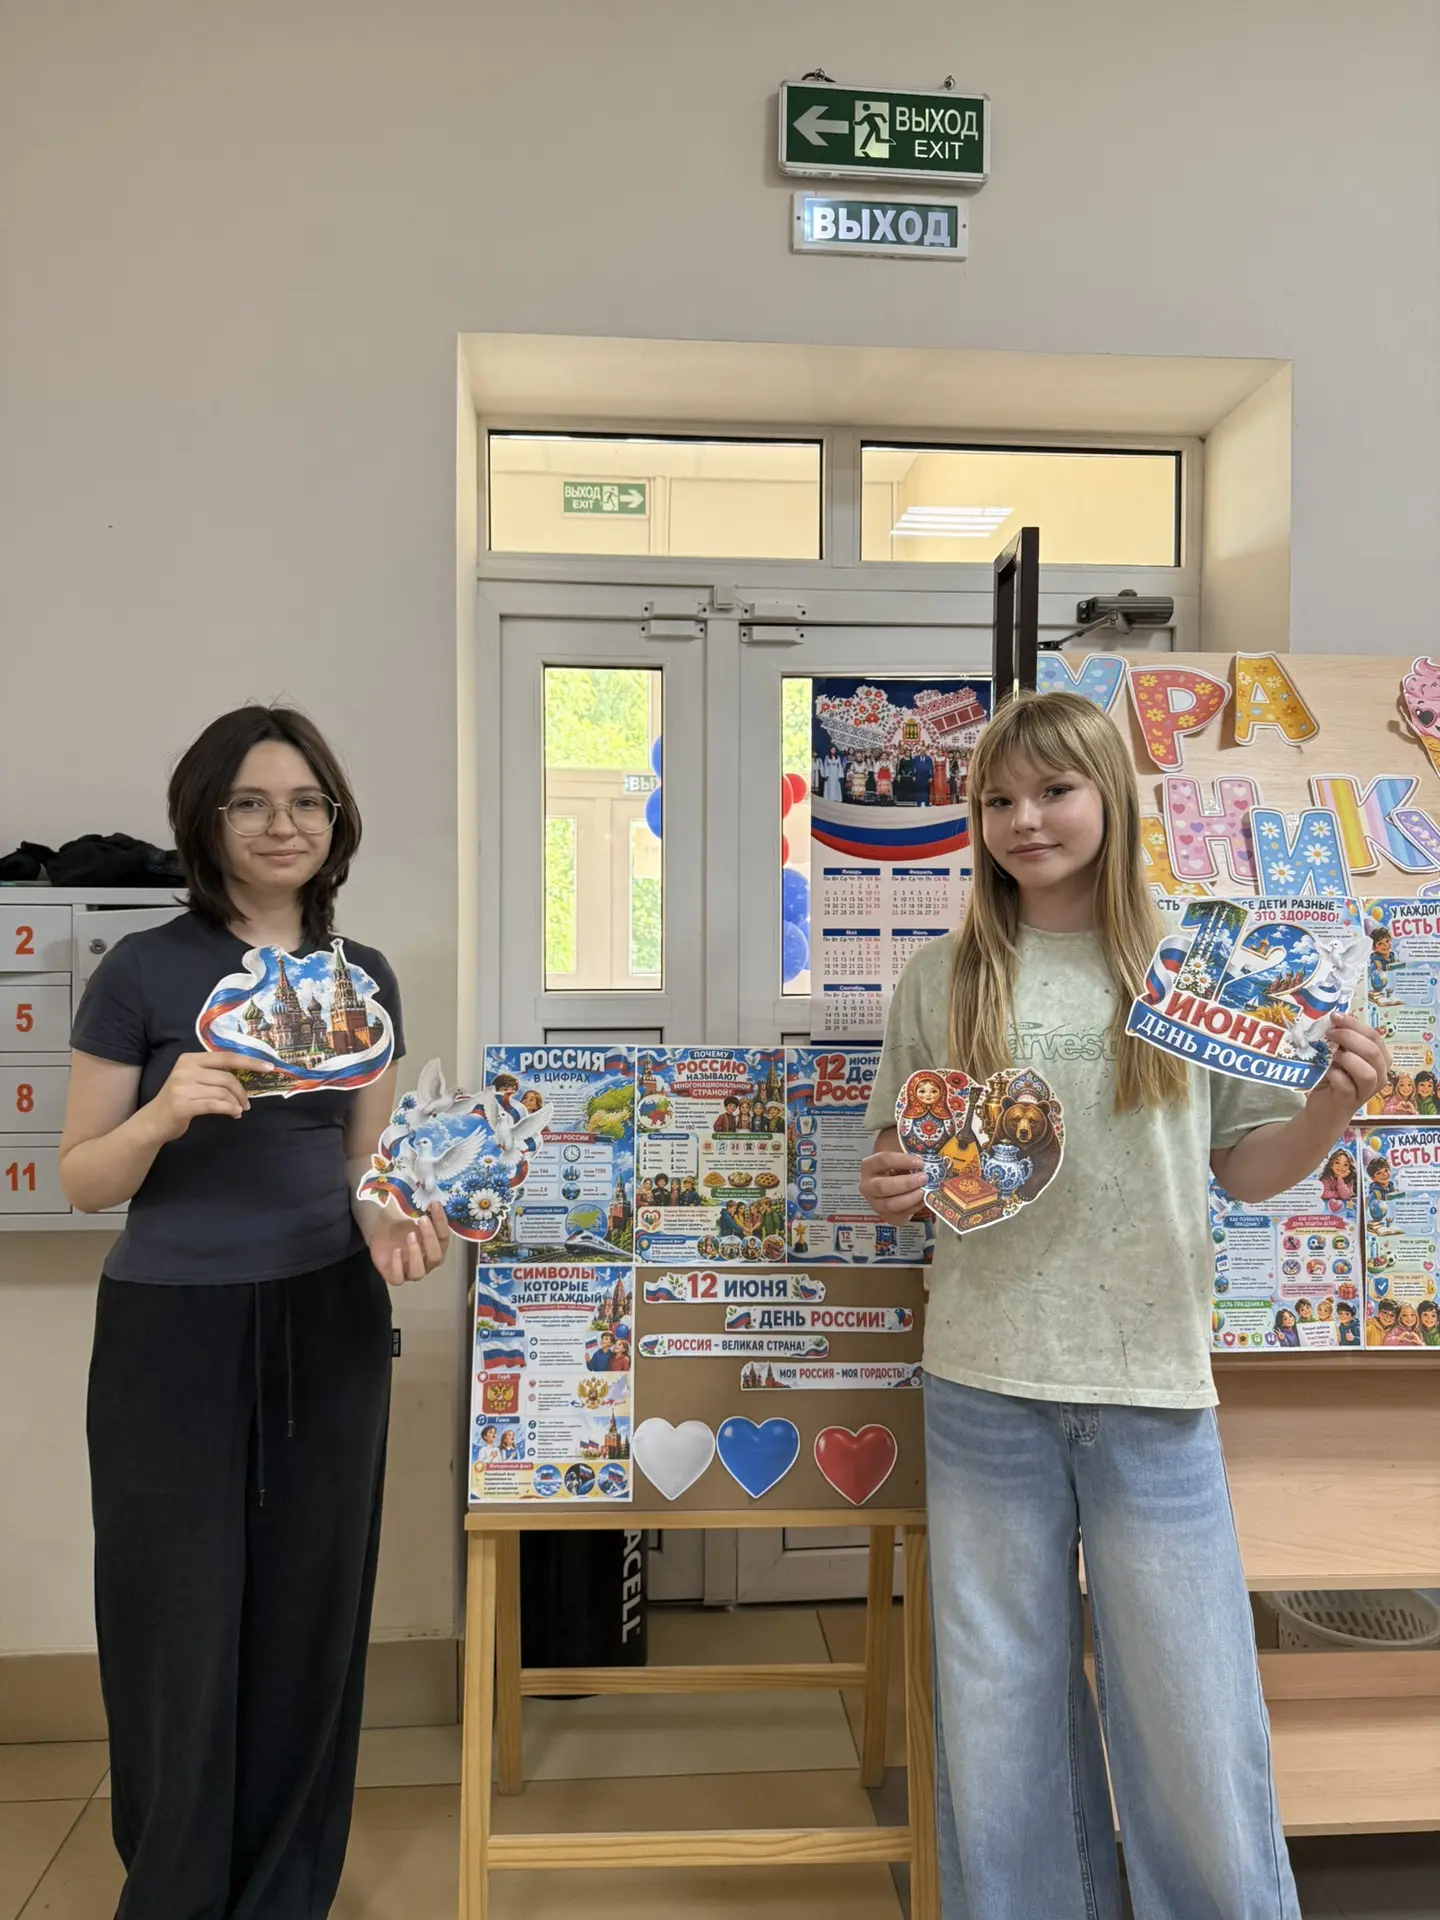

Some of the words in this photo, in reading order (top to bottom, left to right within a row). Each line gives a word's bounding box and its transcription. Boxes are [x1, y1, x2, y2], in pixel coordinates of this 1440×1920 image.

[895, 106, 979, 141] ВЫХОД
[914, 139, 964, 160] EXIT
[812, 206, 951, 246] ВЫХОД
[564, 485, 601, 501] ВЫХОД
[572, 499, 596, 509] EXIT
[1258, 899, 1288, 910] ДЕТИ
[1292, 899, 1335, 911] РАЗНЫЕ
[1391, 907, 1397, 918] У
[1400, 904, 1440, 917] КАЖДОГ
[1255, 911, 1276, 921] ЭТО
[1280, 910, 1340, 922] ЗДОРОВО!
[1392, 917, 1433, 937] ЕСТЬ
[15, 926, 34, 955] 2
[16, 1004, 33, 1032] 5
[1164, 992, 1287, 1056] ИЮНЯ
[694, 1050, 729, 1058] ПОЧЕМУ
[1136, 1012, 1198, 1054] ДЕНЬ
[1202, 1044, 1311, 1085] РОССИИ!
[520, 1049, 605, 1072] РОССИЯ
[676, 1060, 748, 1075] РОССИЮ
[815, 1054, 846, 1081] 12
[534, 1074, 541, 1083] В
[544, 1072, 591, 1083] ЦИФРАХ
[674, 1082, 751, 1090] МНОГОНАЦИОНАЛЬНОЙ
[692, 1089, 733, 1097] СТРАНОЙ?
[16, 1084, 34, 1113] 8
[1389, 1137, 1395, 1148] У
[1390, 1146, 1431, 1167] ЕСТЬ
[5, 1162, 36, 1191] 11
[512, 1266, 599, 1281] СИМВОЛЫ,
[523, 1281, 589, 1292] КОТОРЫЕ
[687, 1273, 718, 1298] 12
[724, 1279, 788, 1298] ИЮНЯ
[511, 1293, 547, 1304] ЗНАЕТ
[550, 1292, 603, 1304] КАЖДЫЙ
[759, 1310, 806, 1328] ДЕНЬ
[811, 1310, 886, 1328] РОССИИ!
[667, 1338, 712, 1351] РОССИЯ
[722, 1339, 764, 1351] ВЕЛИКАЯ
[766, 1339, 805, 1351] СТРАНА!
[779, 1368, 797, 1379] МОЯ
[799, 1368, 834, 1379] РОССИЯ
[842, 1368, 858, 1379] МОЯ
[860, 1368, 905, 1379] ГОРДОСТЬ!
